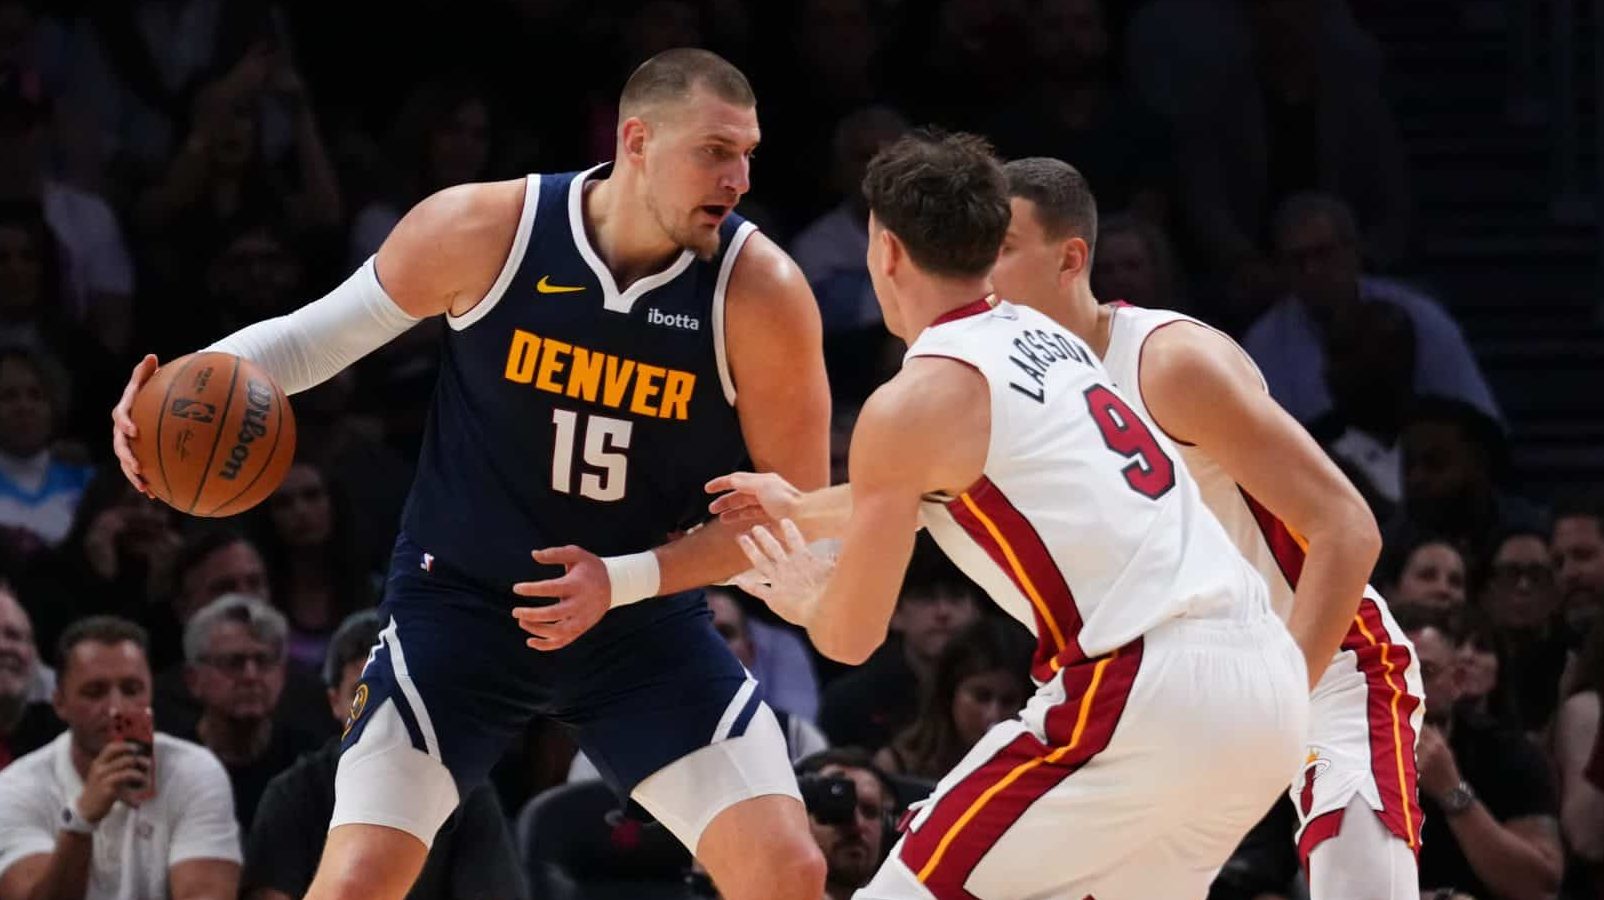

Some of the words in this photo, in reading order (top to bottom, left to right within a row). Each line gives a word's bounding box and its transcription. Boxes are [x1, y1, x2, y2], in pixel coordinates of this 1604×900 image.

[648, 308, 699, 330] ibotta
[504, 328, 696, 420] DENVER
[218, 378, 272, 481] Wilson
[552, 408, 633, 502] 15
[1083, 383, 1176, 500] 9
